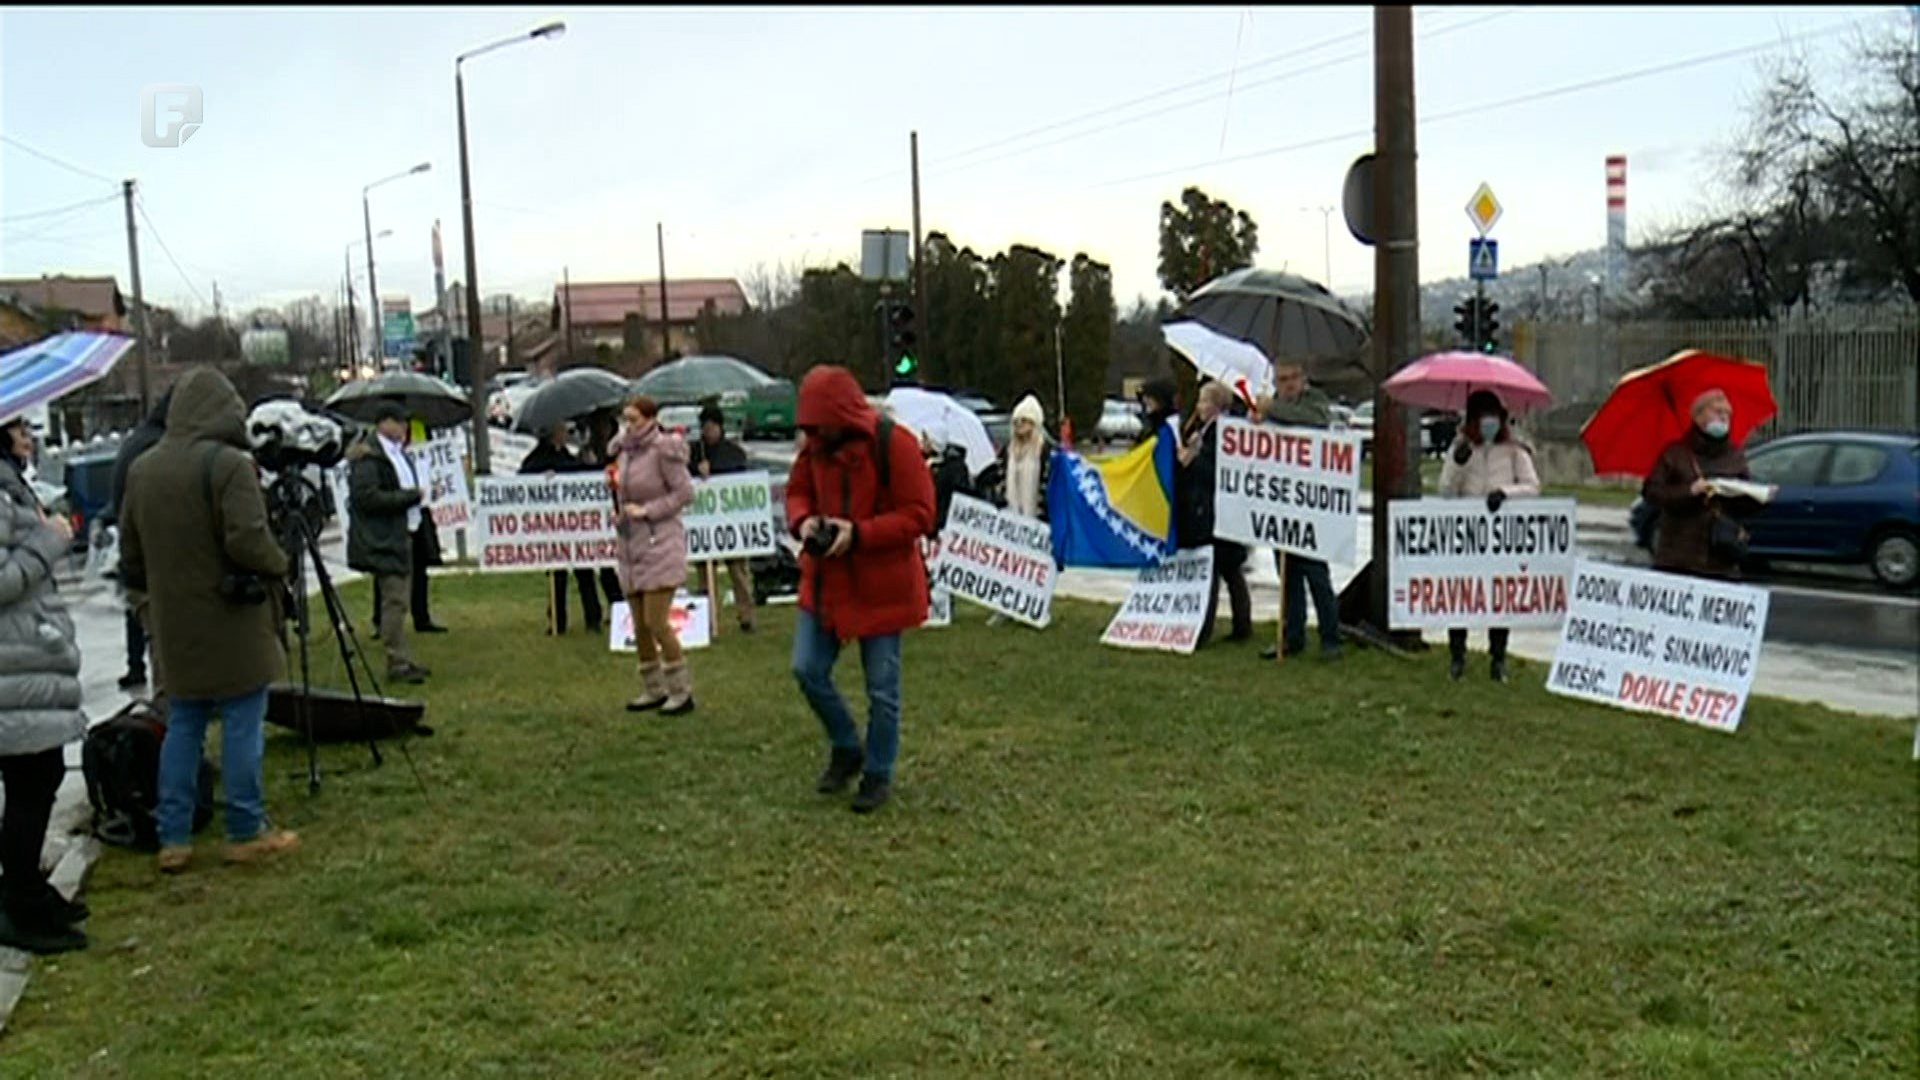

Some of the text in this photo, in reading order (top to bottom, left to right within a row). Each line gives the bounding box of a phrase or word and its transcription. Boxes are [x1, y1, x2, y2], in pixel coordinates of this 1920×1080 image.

[1222, 426, 1353, 474] SUDITE IM
[720, 484, 768, 513] SAMO
[1220, 463, 1351, 516] ILI ĆE SE SUDITI
[489, 512, 518, 535] IVO
[521, 510, 602, 534] SANADER
[684, 521, 772, 554] DU OD VAS
[1251, 511, 1317, 551] VAMA
[1395, 514, 1569, 555] NEZAVISNO SUDSTVO
[484, 541, 572, 567] SEBASTIAN
[948, 531, 1049, 588] ZAUSTAVITE
[937, 561, 1044, 620] KORUPCIJU
[1409, 575, 1487, 616] PRAVNA
[1492, 562, 1567, 615] DRŽAVA
[1575, 573, 1757, 633] DODIK, NOVALIĆ, MEMIĆ,
[1663, 634, 1751, 677] SINANOVIĆ
[1618, 671, 1686, 713] DOKLE
[1685, 686, 1738, 723] STE?
